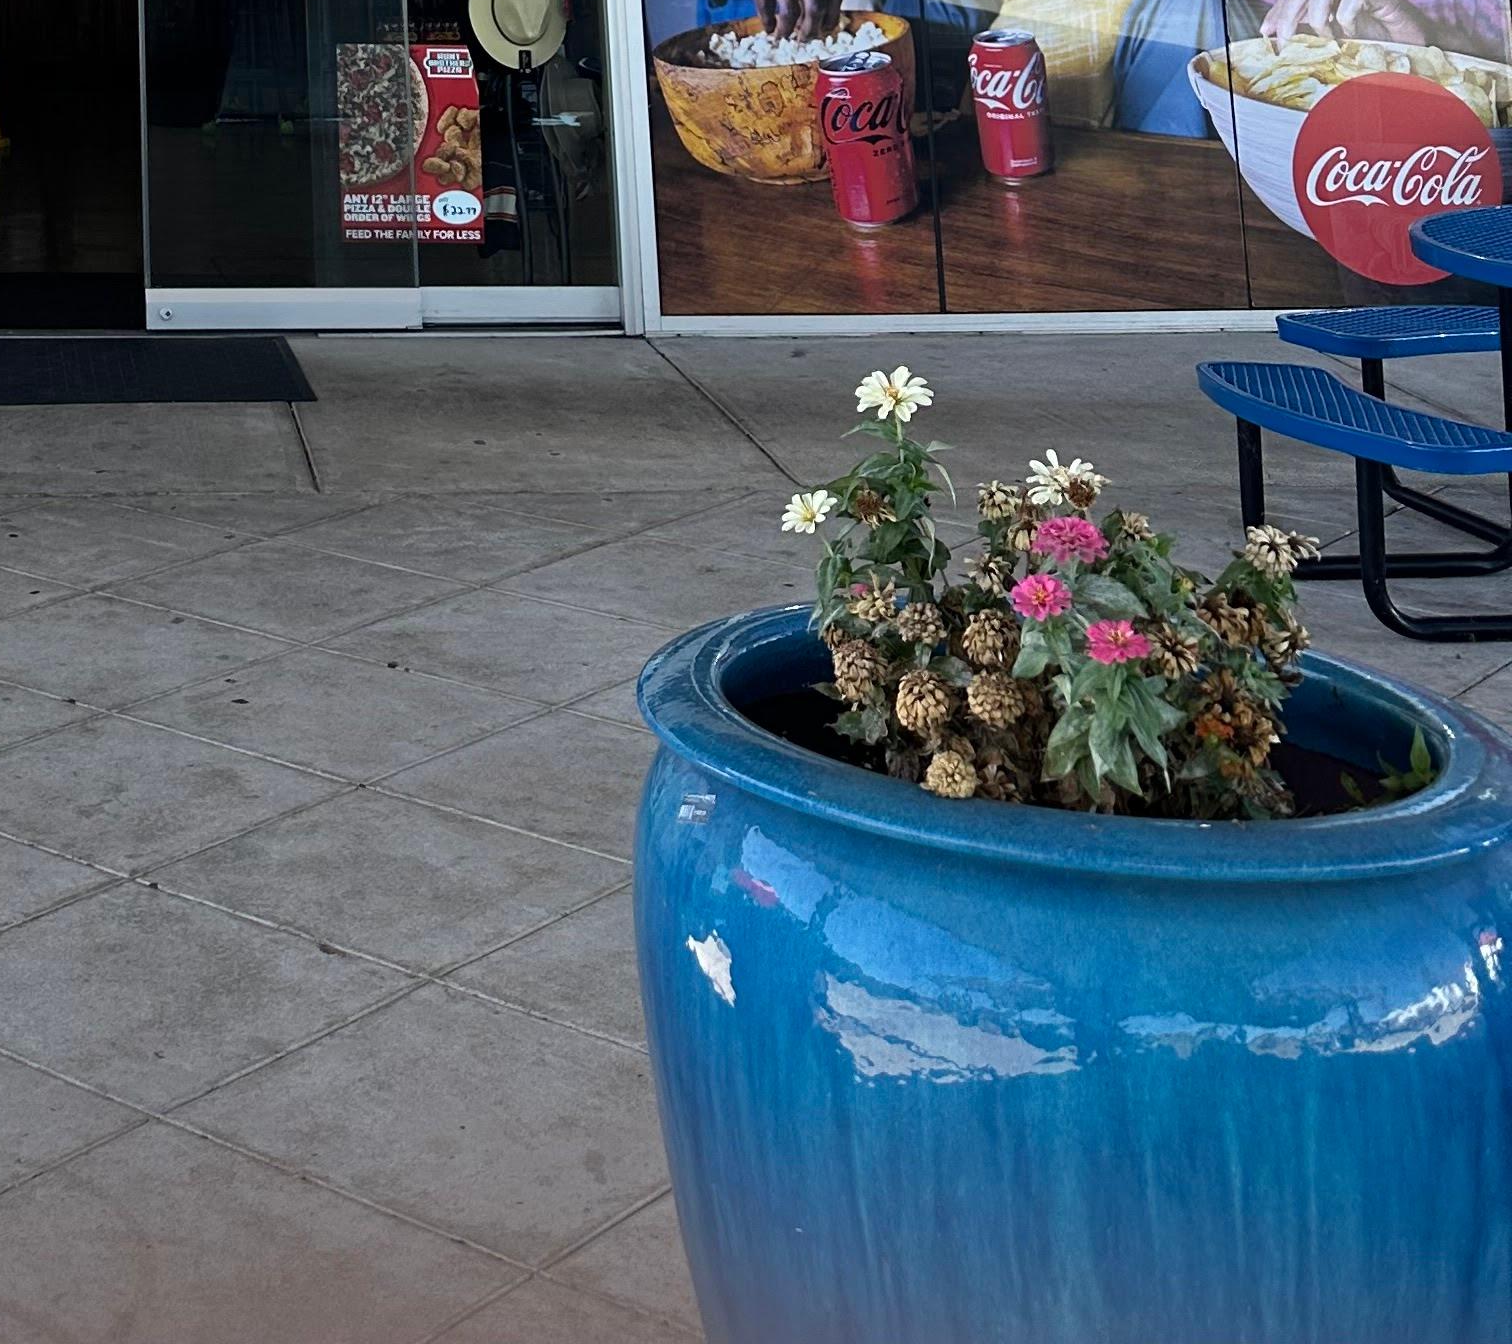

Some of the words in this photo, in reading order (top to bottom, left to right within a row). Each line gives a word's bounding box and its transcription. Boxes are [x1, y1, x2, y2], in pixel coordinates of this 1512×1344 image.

[1305, 145, 1490, 207] Coca-Cola
[344, 194, 369, 204] ANY
[344, 204, 377, 213] PIZZA
[344, 213, 379, 222] ORDER
[381, 213, 394, 222] OF
[395, 213, 432, 222] WIGS
[346, 229, 373, 240] FEED
[374, 229, 395, 240] THE
[433, 229, 456, 240] FOR
[456, 229, 482, 240] LESS
